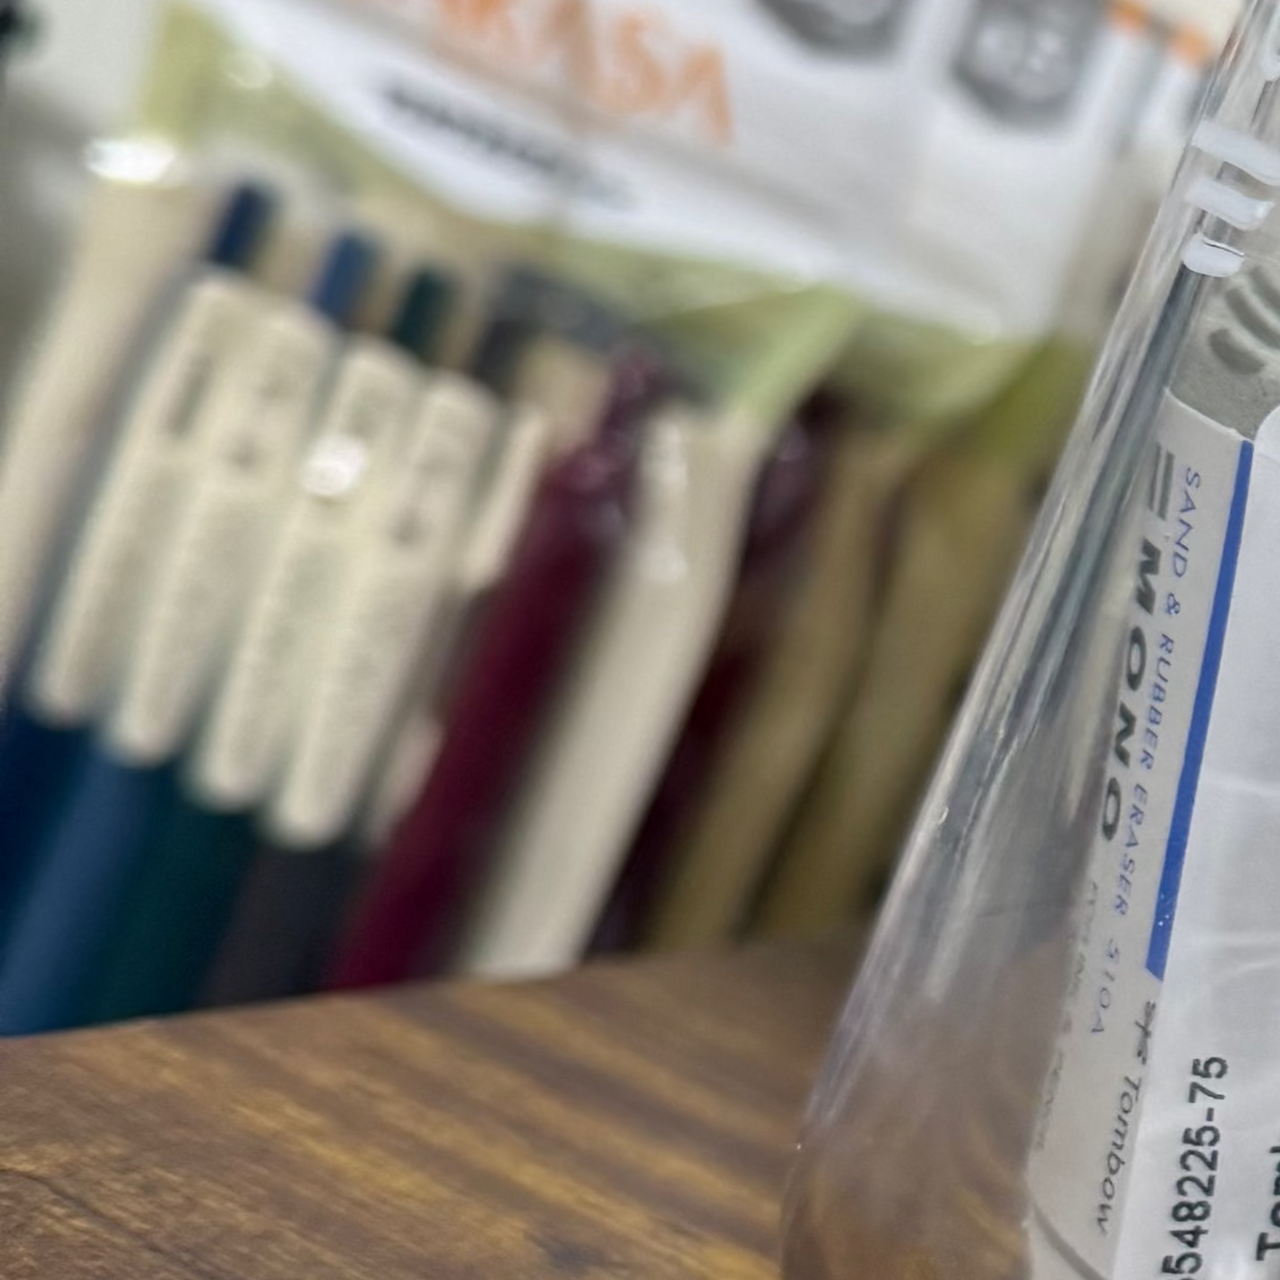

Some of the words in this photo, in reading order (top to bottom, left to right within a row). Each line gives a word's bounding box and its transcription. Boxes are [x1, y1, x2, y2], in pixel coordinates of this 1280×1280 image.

[1167, 465, 1202, 580] SAND
[1163, 593, 1182, 617] &
[1099, 537, 1161, 842] MONO
[1138, 631, 1176, 771] RUBBER
[1113, 782, 1149, 917] ERASER
[1096, 1075, 1142, 1234] Tombow
